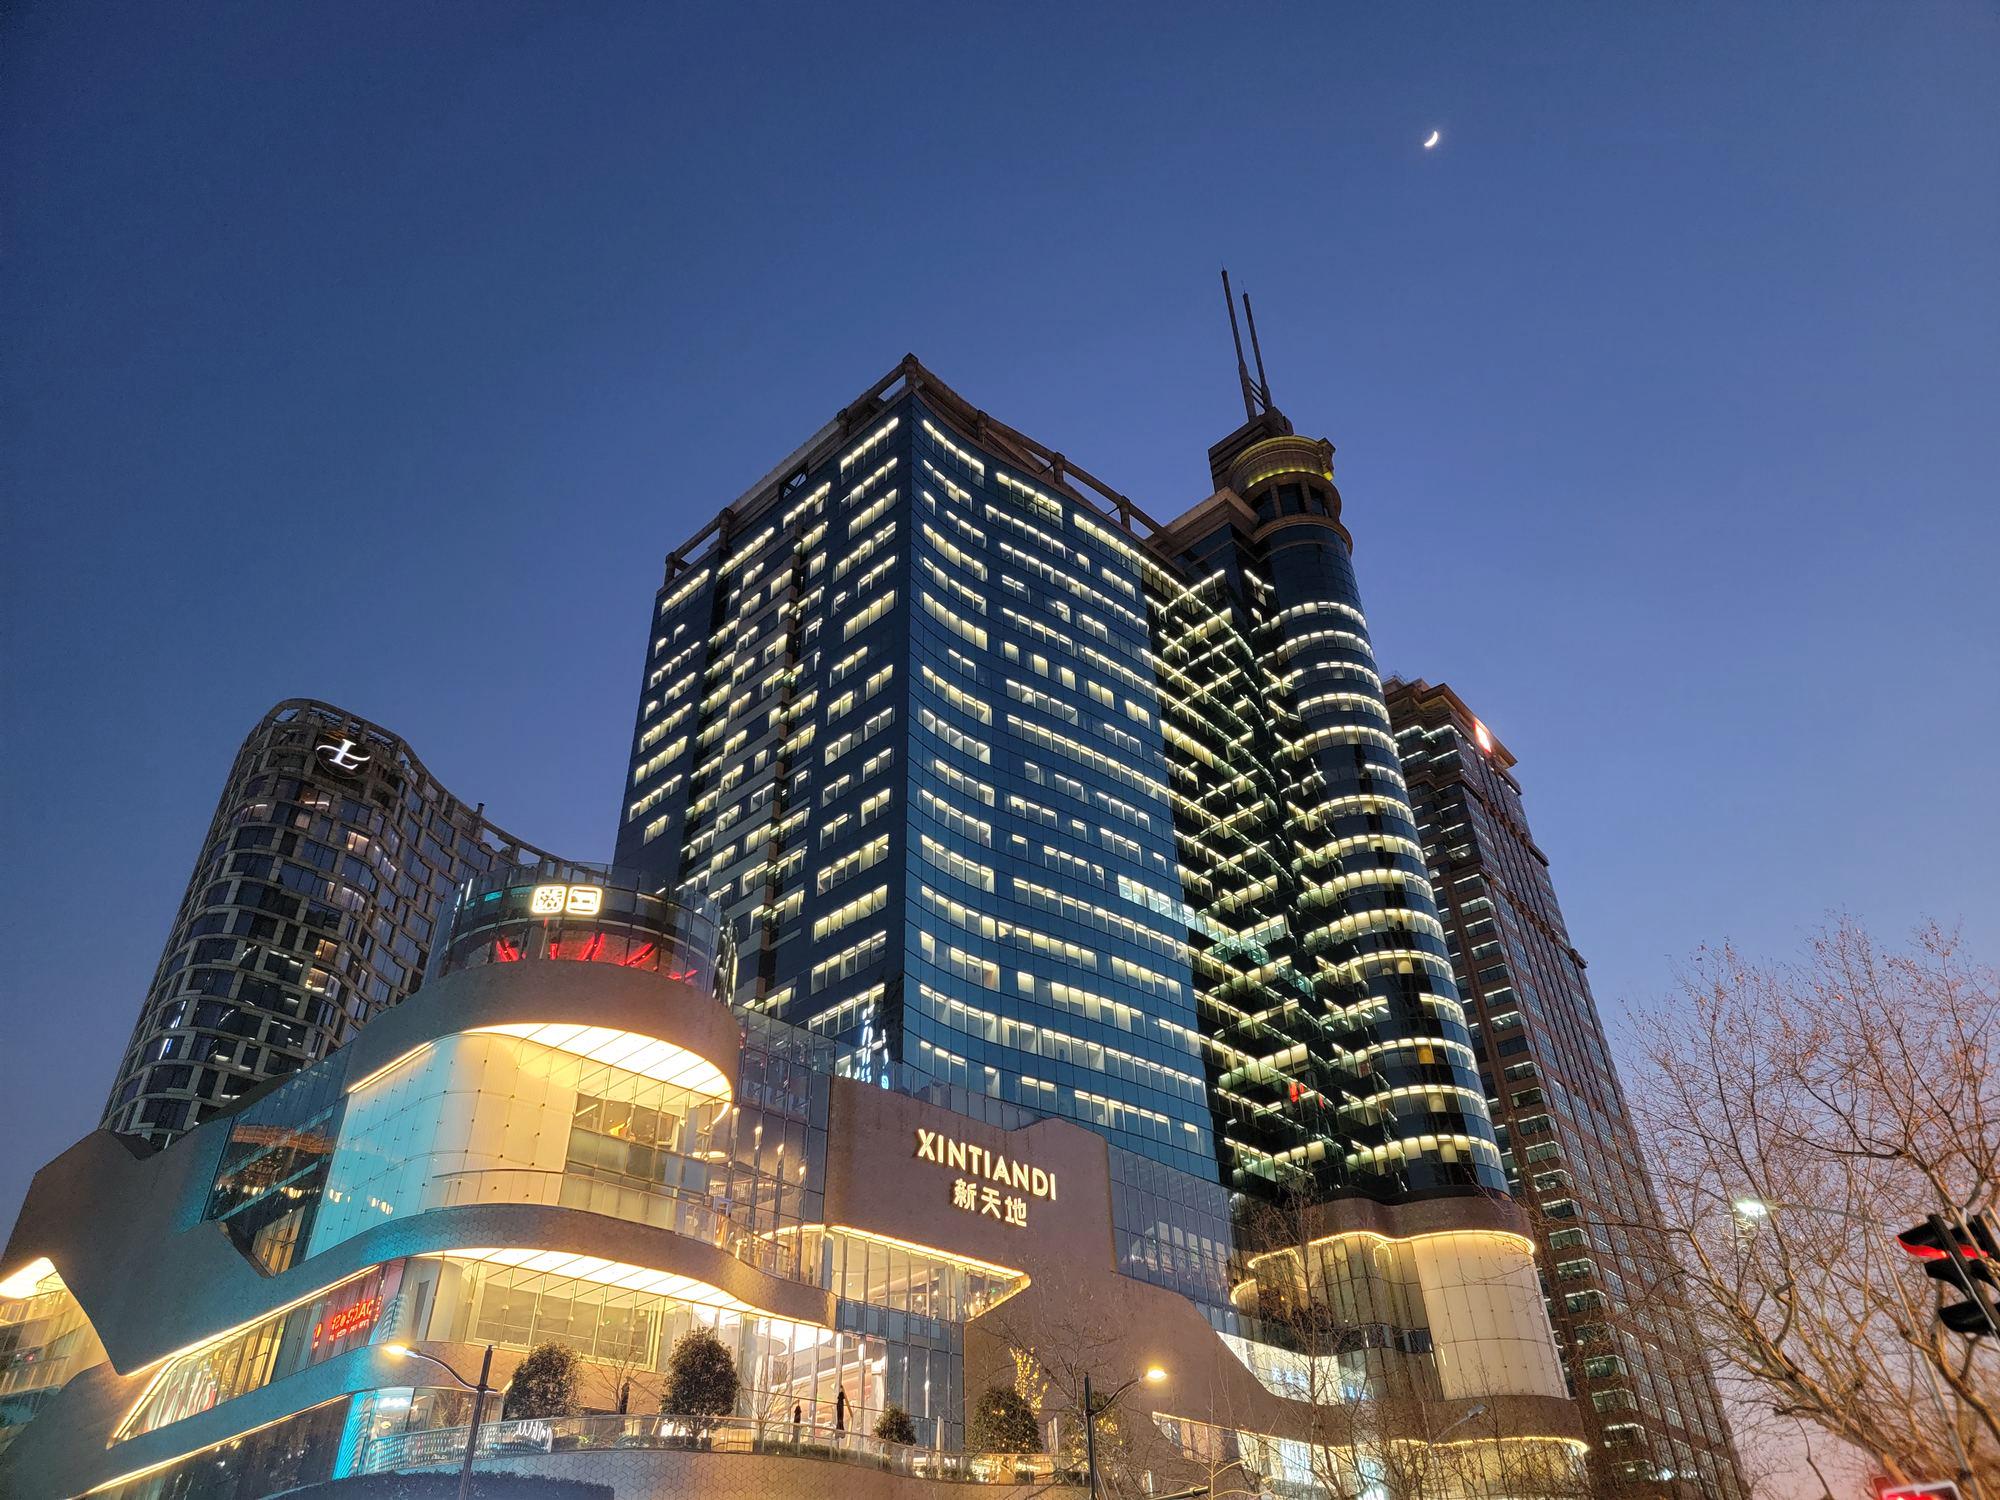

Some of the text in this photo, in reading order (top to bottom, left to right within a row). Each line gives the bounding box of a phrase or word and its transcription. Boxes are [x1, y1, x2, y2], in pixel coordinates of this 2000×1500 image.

[917, 1128, 1057, 1201] XINTIANDI
[953, 1178, 1027, 1228] 新天地
